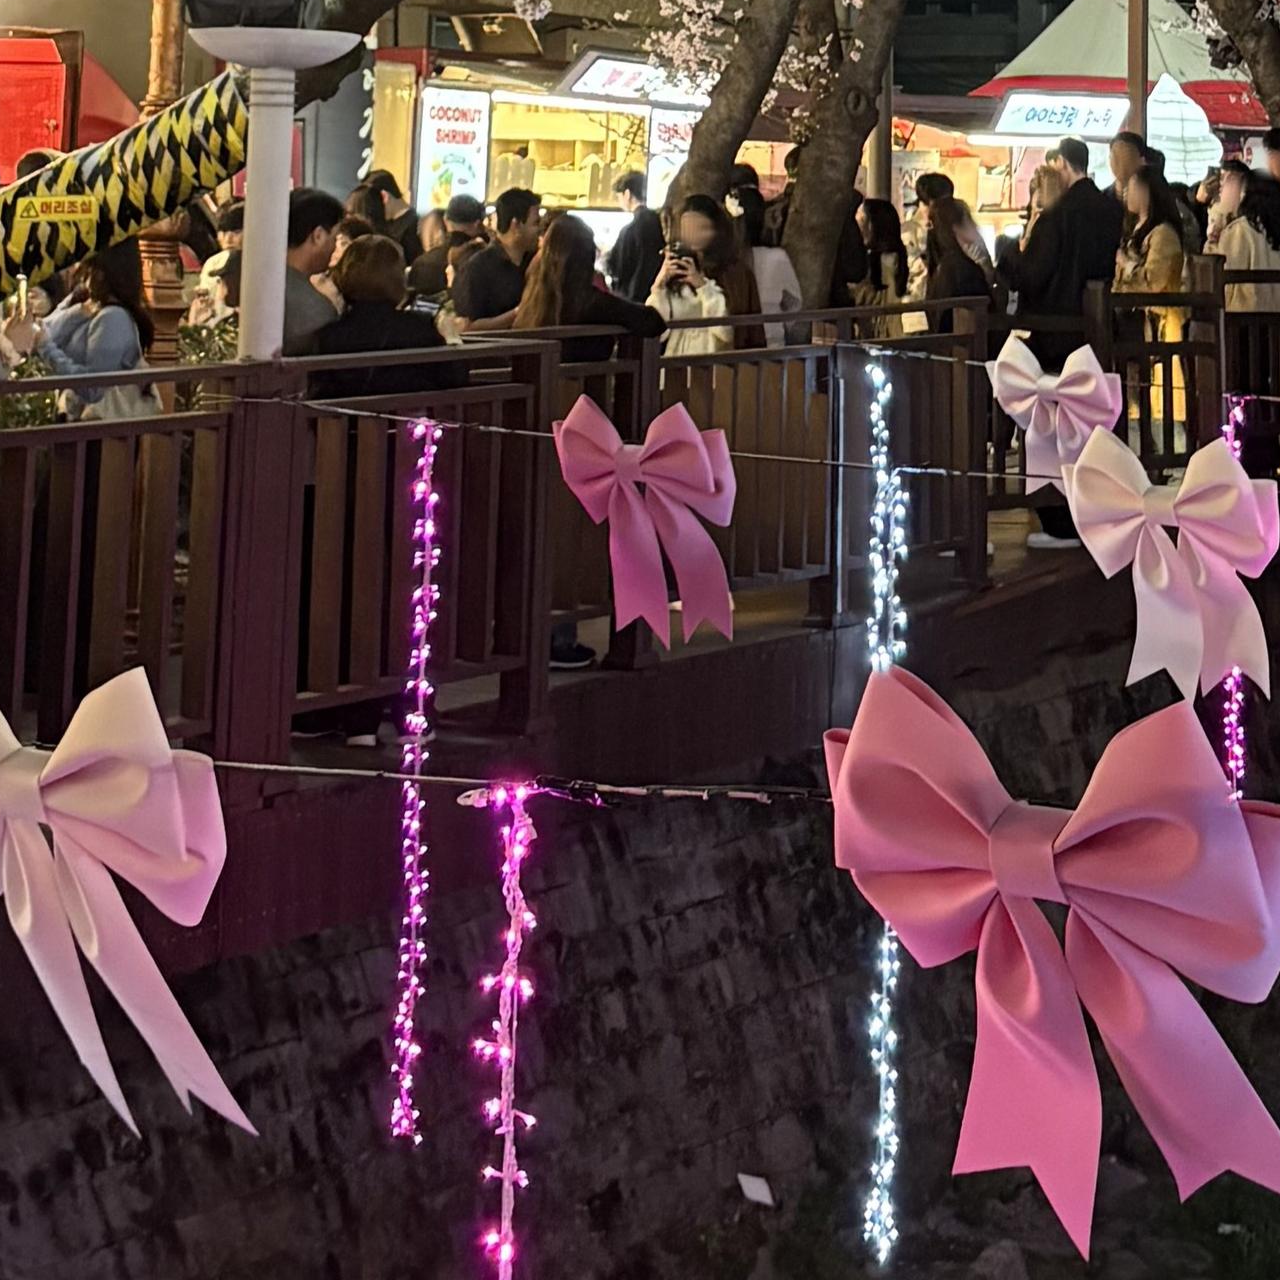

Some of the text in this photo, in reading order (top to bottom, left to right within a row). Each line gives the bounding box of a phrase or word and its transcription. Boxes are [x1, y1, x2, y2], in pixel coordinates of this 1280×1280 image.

[429, 106, 483, 123] COCONUT
[436, 128, 476, 144] SHRIMP
[40, 200, 92, 214] 머리조심
